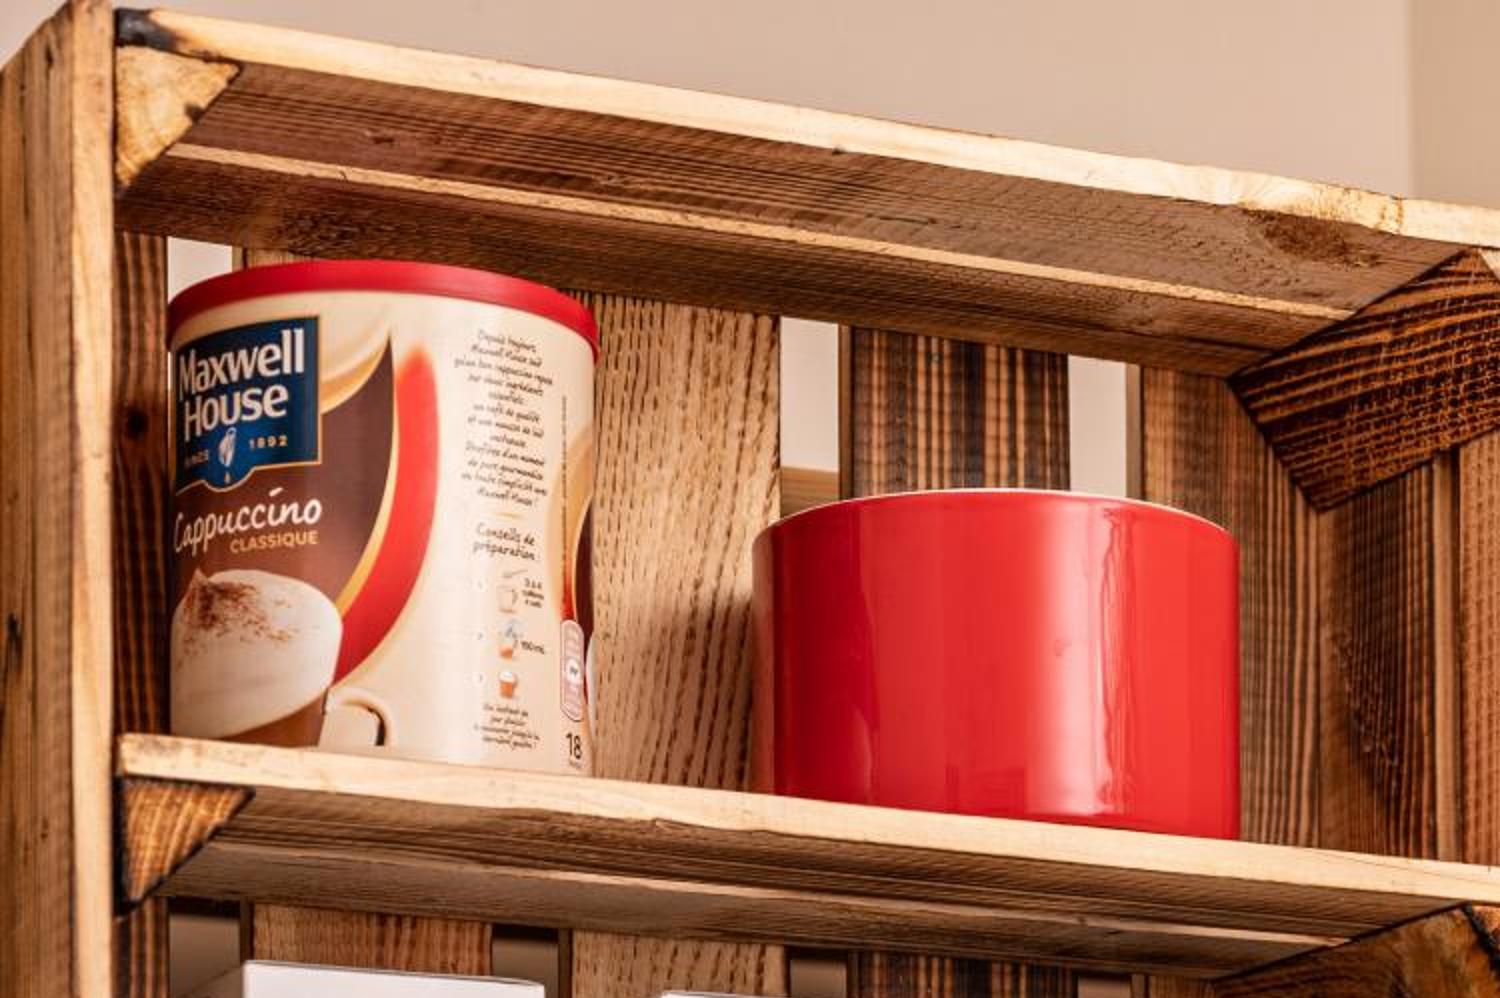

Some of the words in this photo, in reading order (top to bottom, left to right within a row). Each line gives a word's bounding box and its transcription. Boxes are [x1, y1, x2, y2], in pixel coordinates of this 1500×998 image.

[177, 328, 305, 401] Maxwell
[185, 384, 290, 442] House
[250, 434, 288, 449] 1892
[174, 487, 323, 556] Cappuccino
[230, 530, 319, 554] CLASSIQUE
[566, 732, 583, 759] 18
